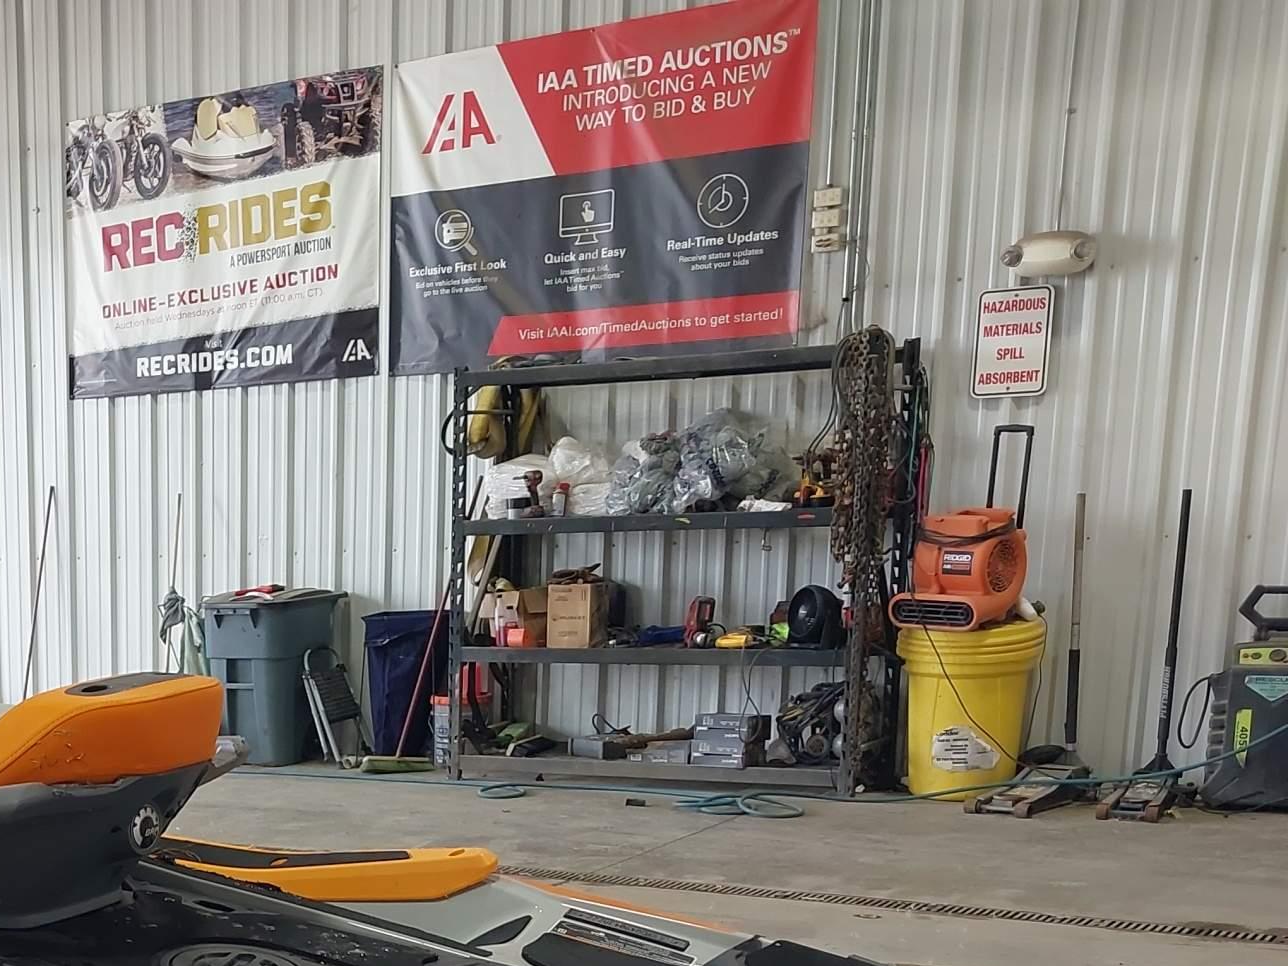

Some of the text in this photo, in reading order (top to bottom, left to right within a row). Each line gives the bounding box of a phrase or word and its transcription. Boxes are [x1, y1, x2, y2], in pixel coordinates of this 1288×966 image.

[538, 70, 578, 95] IAA
[582, 54, 653, 89] TIMED
[562, 60, 773, 111] INTRODUCING A NEW
[575, 86, 757, 132] WAY TO BID & BUY
[666, 230, 780, 252] Real-Time Updates
[229, 236, 333, 268] A POWERSPORT AUCTION
[544, 247, 627, 265] Quick and Easy
[678, 247, 765, 264] Receive status updates
[408, 258, 507, 278] Exclusive First Look
[559, 267, 580, 276] Insert
[691, 258, 750, 272] about your bids
[434, 278, 461, 287] vehicles
[461, 276, 482, 285] before
[554, 275, 568, 285] IAA
[566, 282, 603, 293] bid for you
[102, 263, 339, 319] ONLINE-EXCLUSIVE AUCTION
[307, 287, 323, 298] CT)
[423, 290, 432, 298] go
[439, 287, 451, 295] the
[451, 286, 464, 294] live
[464, 284, 488, 293] auction
[983, 297, 1047, 314] HAZARDOUS
[518, 308, 784, 341] Visit IAAI.com/TimedAuctions to get started!
[983, 321, 1043, 338] MATERIALS
[204, 338, 223, 349] Visit
[135, 343, 294, 378] RECRIDES.COM
[996, 347, 1025, 361] SPILL
[977, 369, 1041, 386] ABSORBENT
